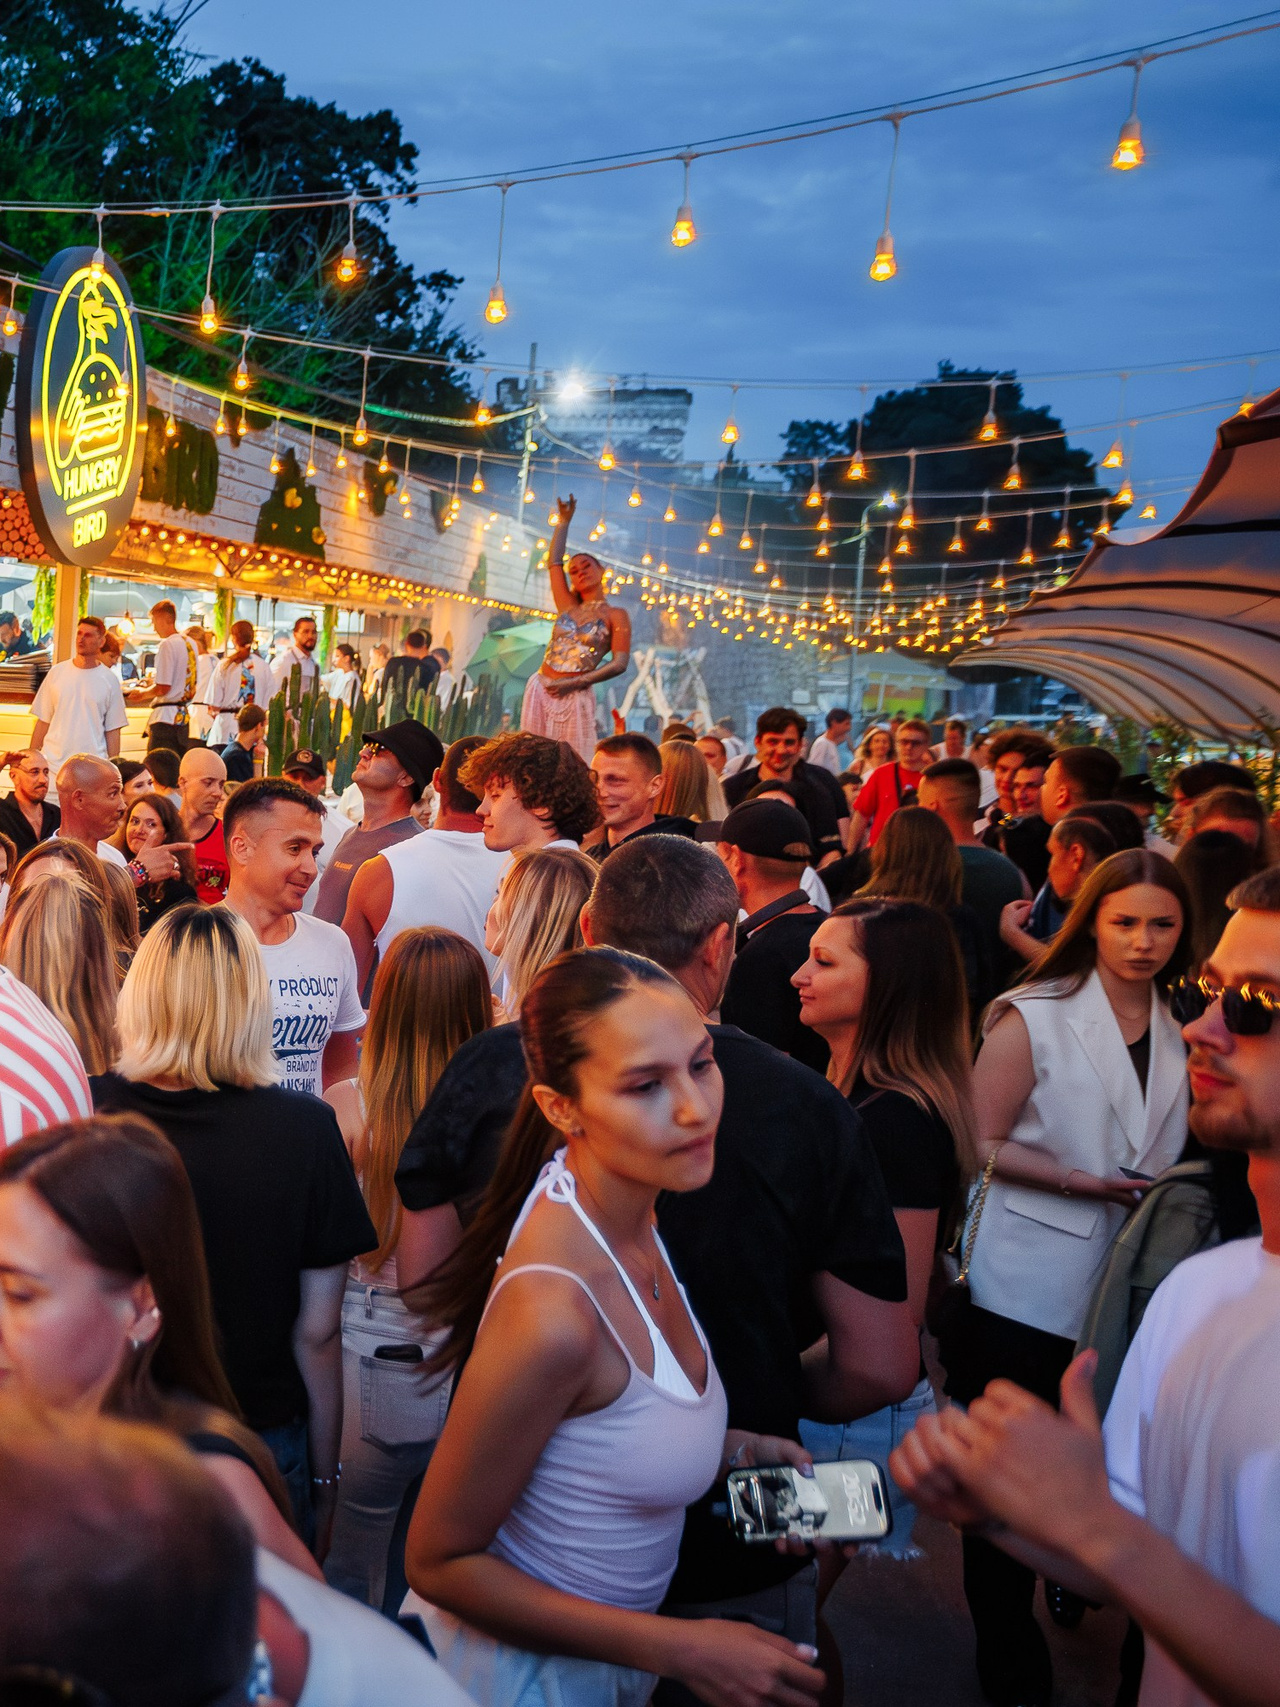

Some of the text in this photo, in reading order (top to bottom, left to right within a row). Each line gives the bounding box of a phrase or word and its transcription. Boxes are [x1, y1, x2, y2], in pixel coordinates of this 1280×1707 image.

[63, 454, 123, 501] HUNGRY
[73, 509, 108, 549] BIRD
[279, 977, 338, 998] PRODUCT
[286, 1060, 309, 1072] BRAND
